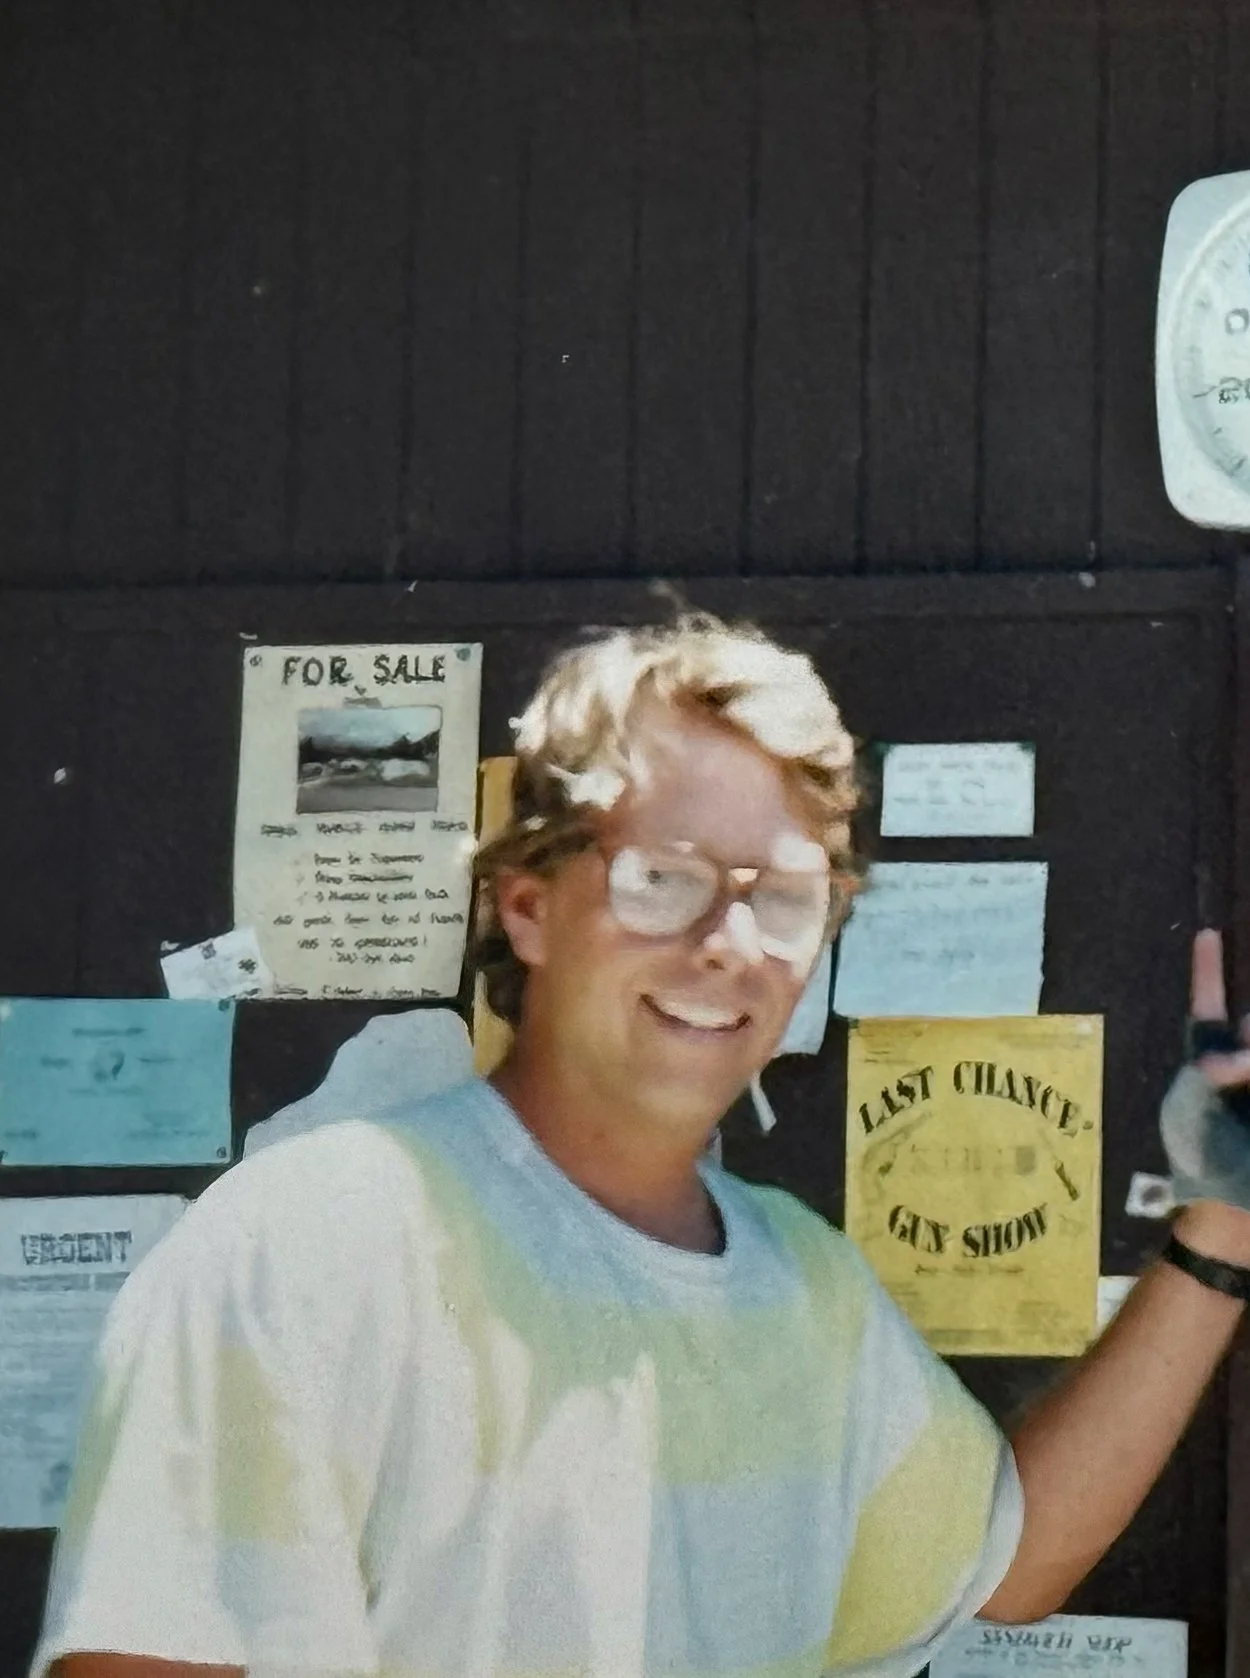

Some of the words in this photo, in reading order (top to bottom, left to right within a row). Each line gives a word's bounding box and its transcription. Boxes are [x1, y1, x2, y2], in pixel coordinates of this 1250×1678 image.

[1224, 307, 1250, 334] 0
[281, 656, 351, 687] FOR
[373, 654, 447, 685] SALE
[858, 1065, 935, 1134] LAST
[20, 1229, 133, 1266] URGENT
[888, 1204, 950, 1256] GUN
[962, 1202, 1048, 1259] SHOW
